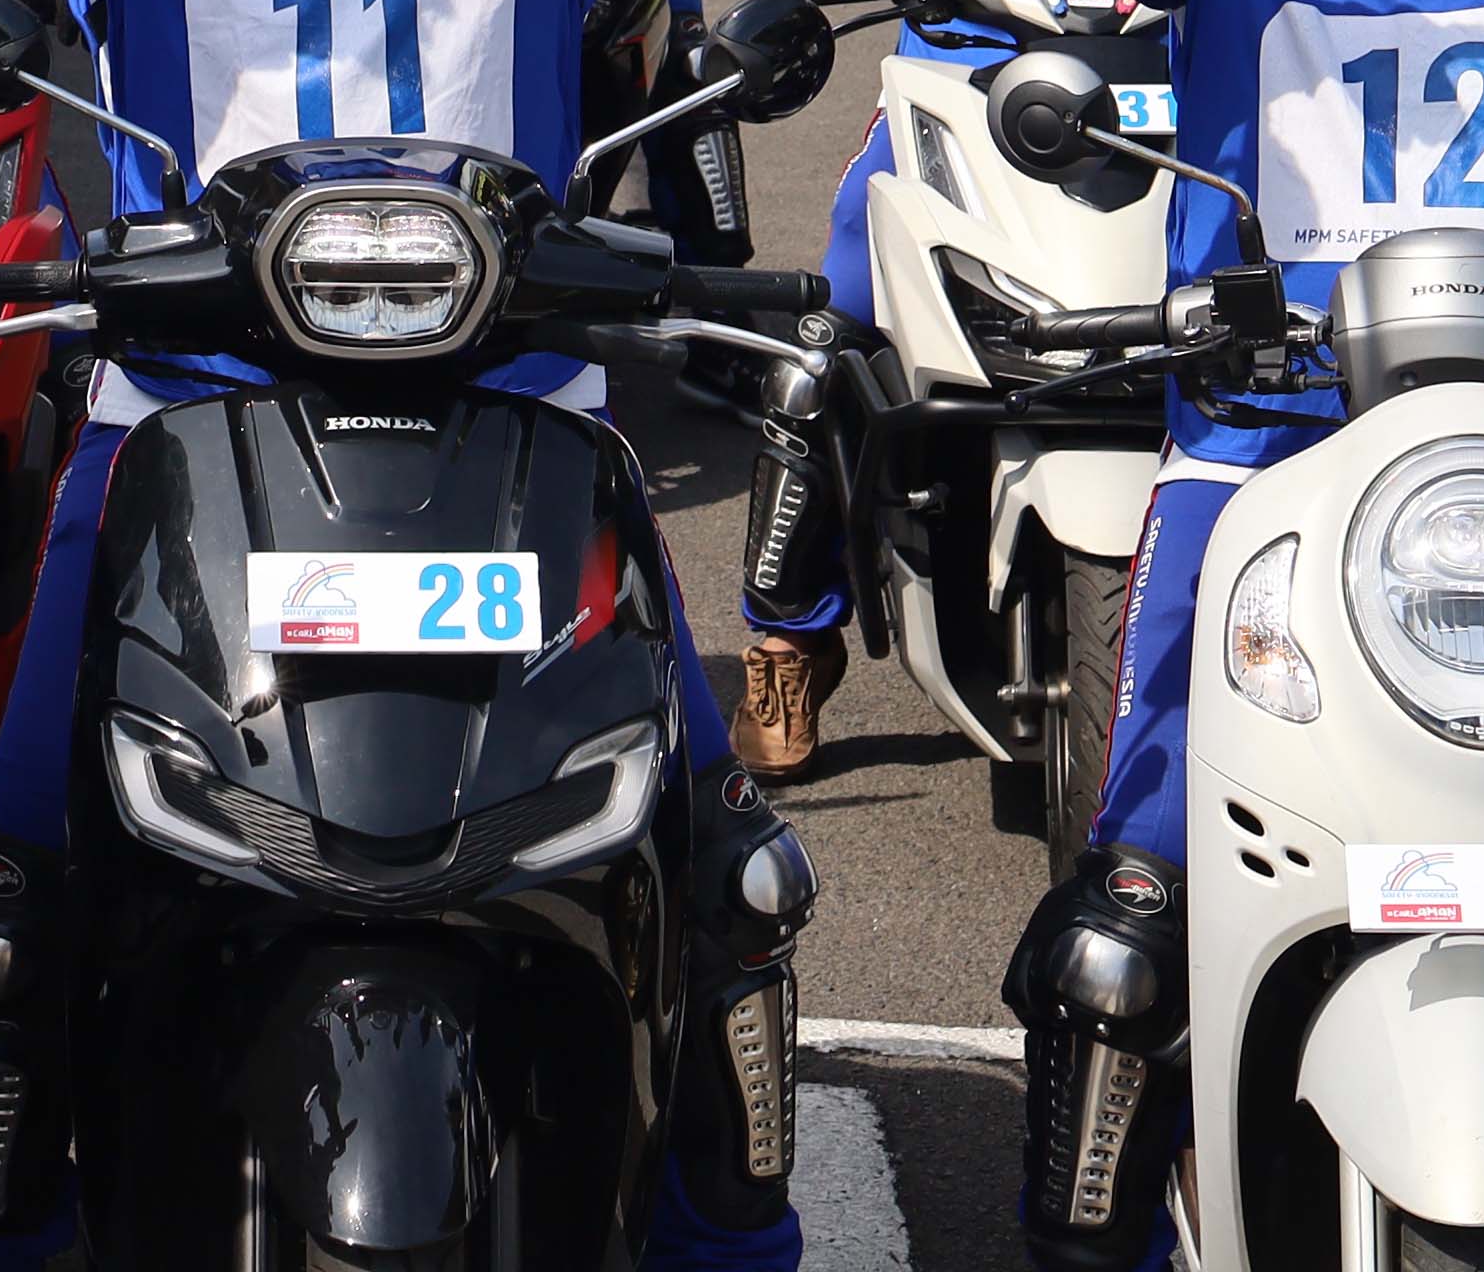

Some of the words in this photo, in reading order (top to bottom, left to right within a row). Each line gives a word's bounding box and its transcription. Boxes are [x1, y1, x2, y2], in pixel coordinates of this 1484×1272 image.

[1117, 90, 1179, 128] 31
[1294, 229, 1332, 244] MPM
[1335, 228, 1405, 245] SAFETY
[325, 416, 436, 432] HONDA
[418, 562, 524, 641] 28
